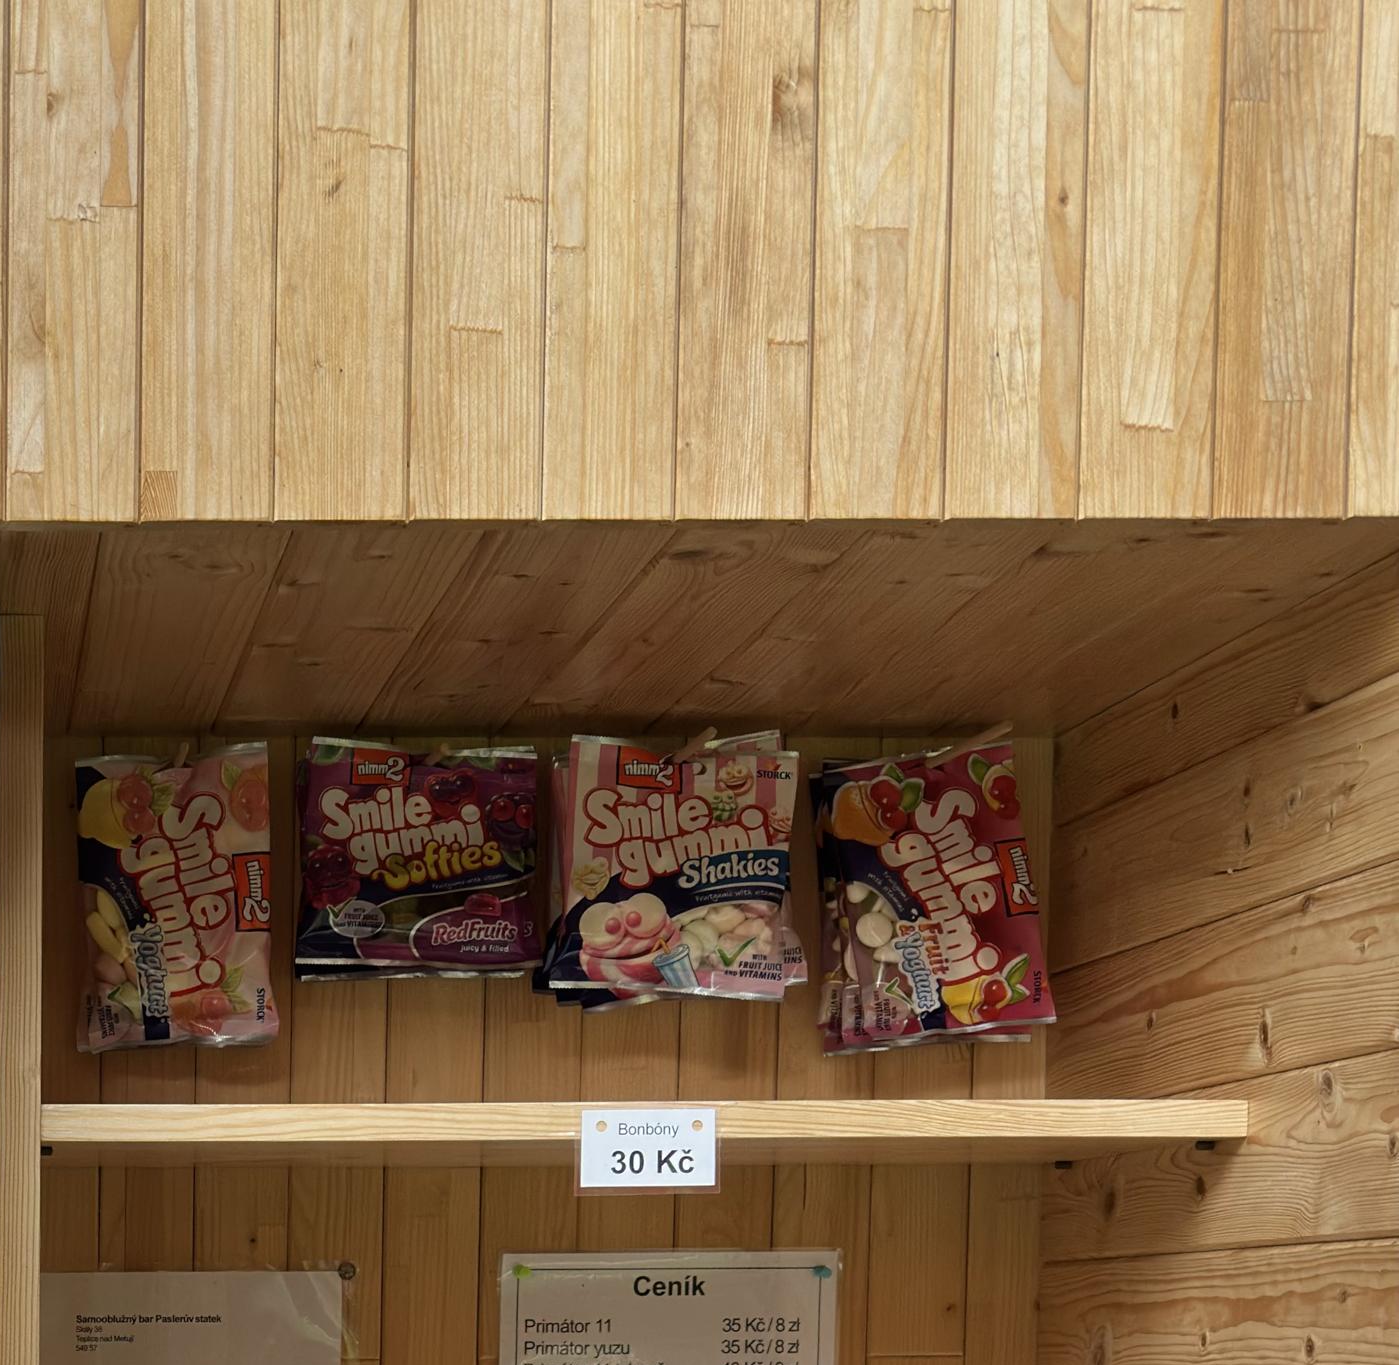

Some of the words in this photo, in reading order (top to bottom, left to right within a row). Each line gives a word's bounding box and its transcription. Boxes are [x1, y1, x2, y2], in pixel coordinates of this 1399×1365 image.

[357, 757, 404, 779] nimm2
[756, 770, 791, 780] STORCK
[319, 786, 433, 839] Smile
[349, 805, 487, 873] gummi
[385, 840, 500, 889] Softies
[677, 854, 779, 888] Shakies
[738, 961, 761, 971] FRUIT
[763, 963, 782, 972] JUICE
[739, 970, 782, 981] VITAMINS
[619, 1123, 679, 1138] Bonbóny
[611, 1151, 644, 1174] 30
[658, 1150, 693, 1173] Kč
[634, 1276, 704, 1296] Ceník
[525, 1319, 590, 1333] Primátor
[597, 1319, 610, 1332] 11
